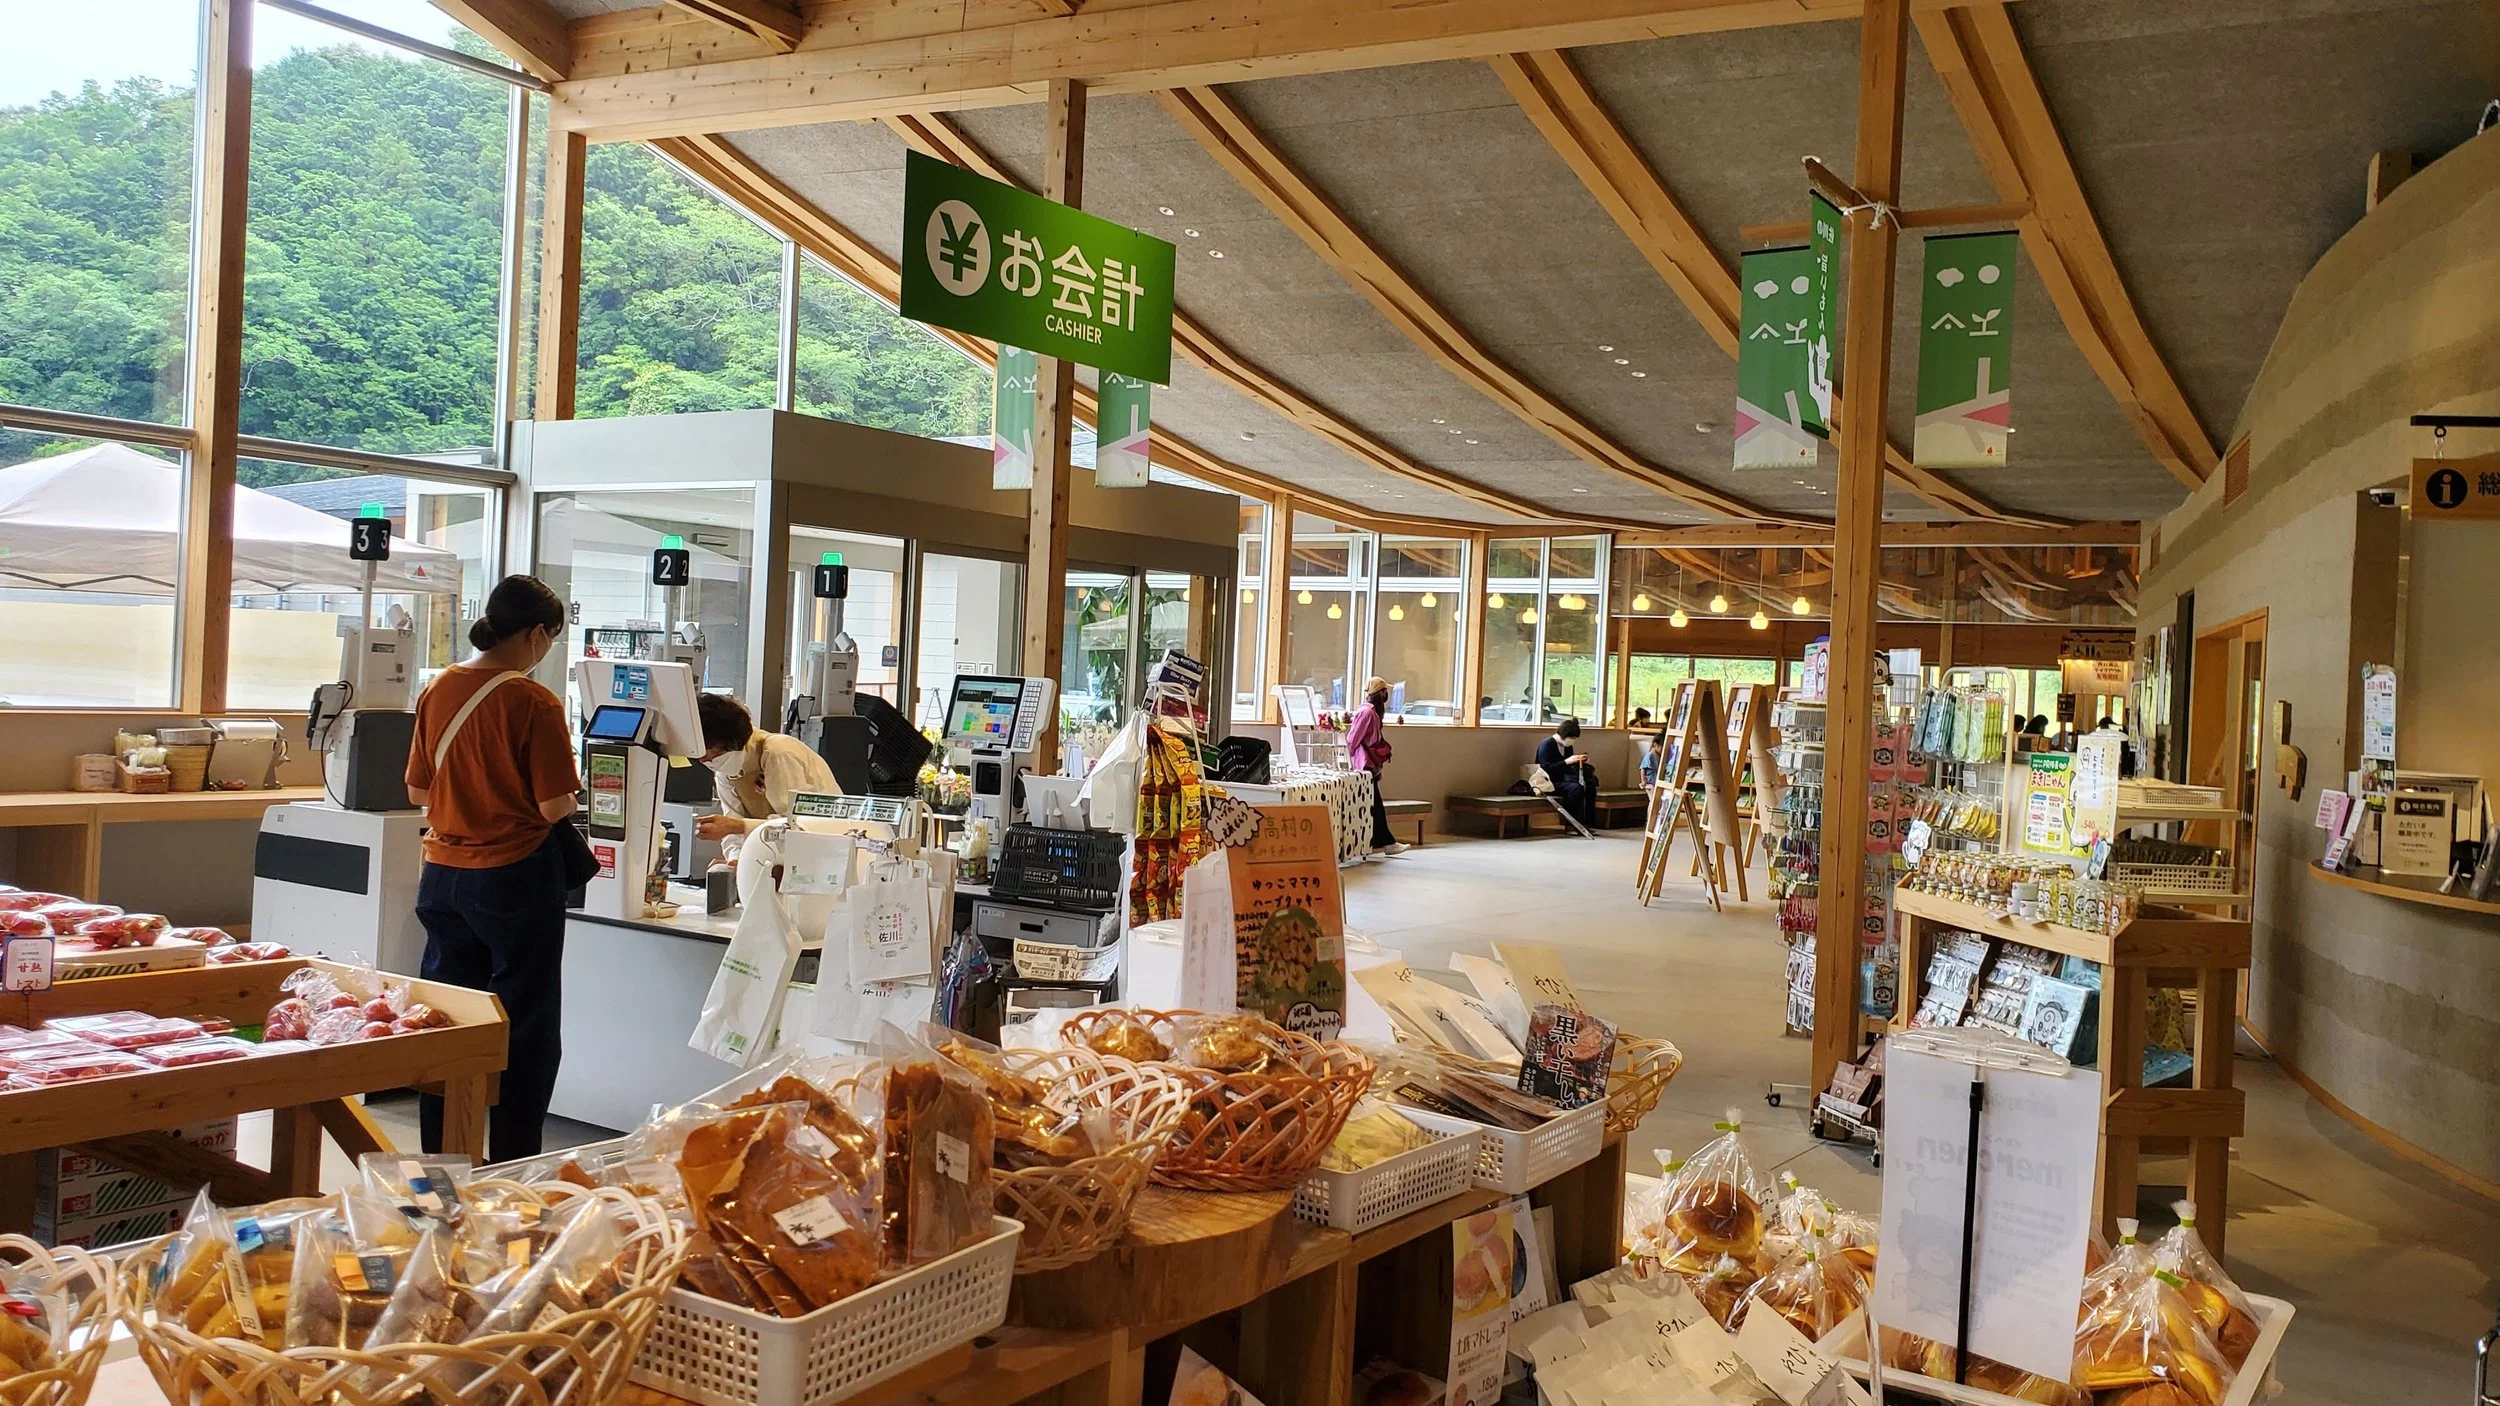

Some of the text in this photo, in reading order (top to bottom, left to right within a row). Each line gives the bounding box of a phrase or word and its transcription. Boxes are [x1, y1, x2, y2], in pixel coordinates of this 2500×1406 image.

[1000, 228, 1145, 332] お会計
[1044, 313, 1103, 345] CASHIER
[357, 524, 371, 552] 3
[380, 529, 389, 550] 3
[659, 554, 672, 580] 2
[681, 559, 688, 577] 2
[822, 569, 831, 593] 1
[2031, 771, 2067, 788] まきにゃん
[1254, 814, 1314, 840] 高村の
[2399, 820, 2427, 829] ただいま
[1253, 892, 1324, 908] ハーブクッキー
[878, 930, 899, 943] 佐川
[16, 979, 41, 989] トマト
[1547, 1013, 1579, 1111] 黒い干し
[1455, 1321, 1507, 1357] 土佐マドレーヌ
